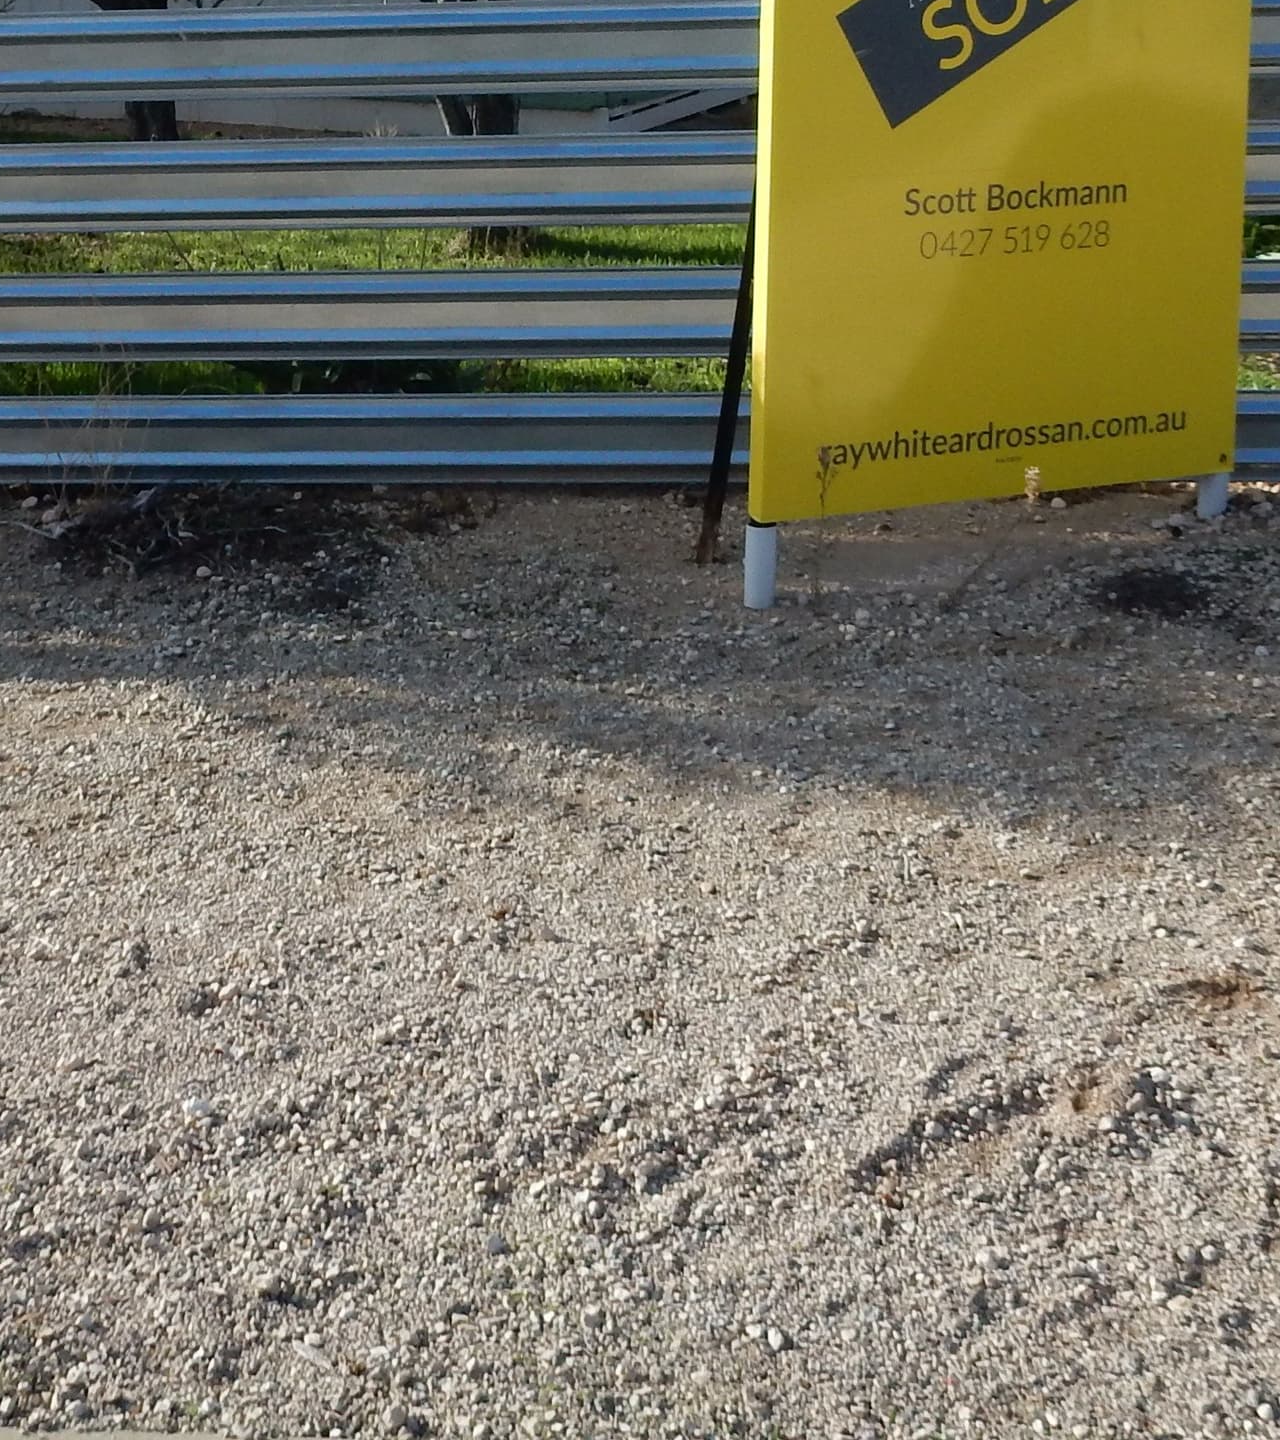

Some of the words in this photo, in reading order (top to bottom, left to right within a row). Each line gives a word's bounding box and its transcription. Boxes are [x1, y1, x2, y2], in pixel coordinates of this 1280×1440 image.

[904, 187, 977, 216] Scott
[987, 181, 1128, 212] Bockmann
[920, 228, 993, 260] 0427
[1003, 224, 1051, 254] 519
[1060, 219, 1111, 250] 628
